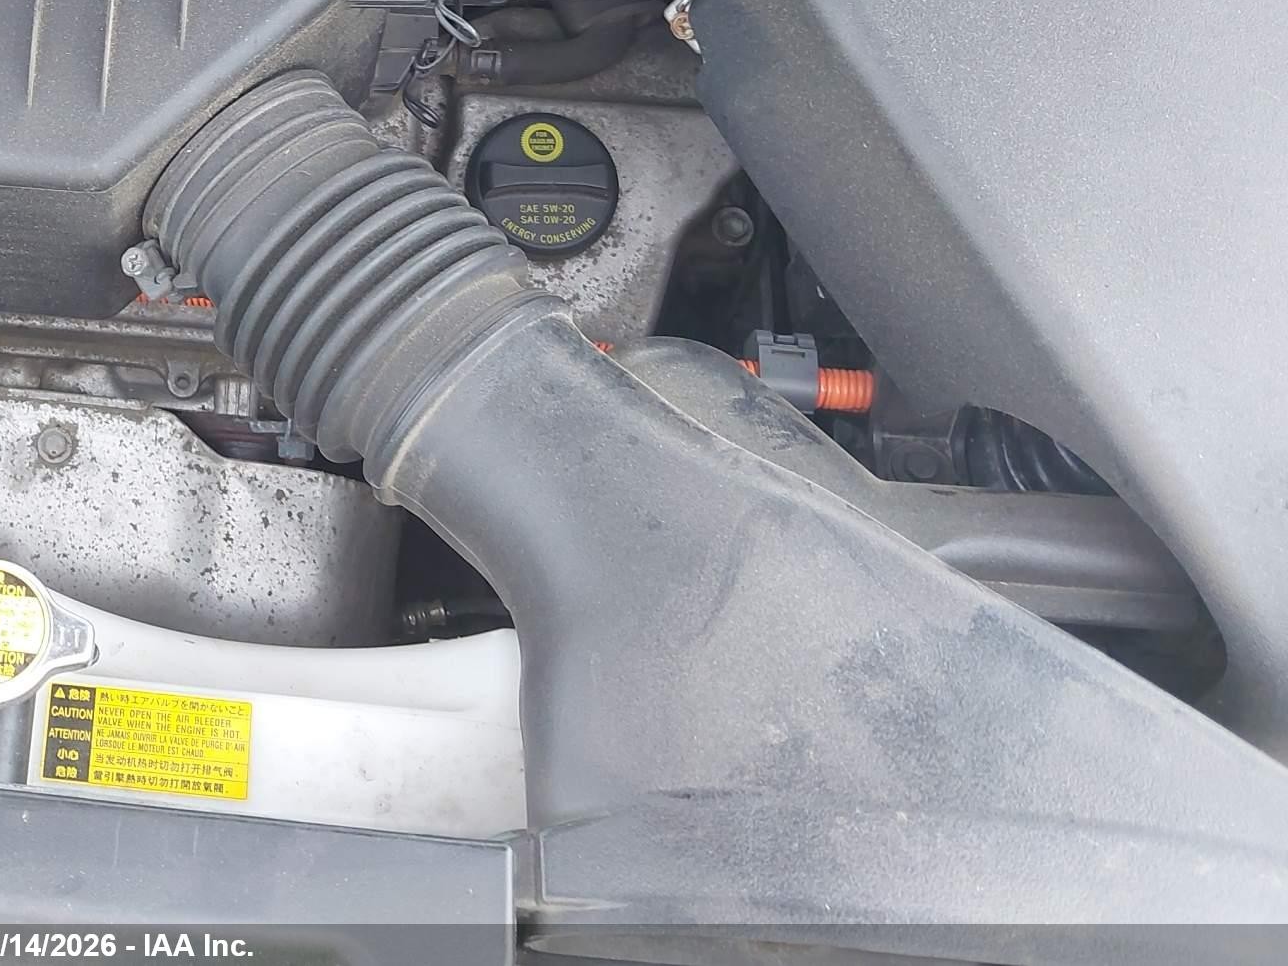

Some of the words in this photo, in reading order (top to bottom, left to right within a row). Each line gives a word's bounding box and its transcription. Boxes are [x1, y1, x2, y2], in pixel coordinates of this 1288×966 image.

[519, 204, 540, 214] SAE
[542, 204, 575, 214] 5W-20
[520, 215, 541, 225] SAE
[543, 215, 577, 225] 0W-20
[502, 217, 537, 241] ENERGY
[539, 217, 596, 244] CONSERVING
[51, 705, 93, 721] CAUTION
[99, 707, 125, 718] NEVER
[129, 709, 152, 720] OPEN
[157, 712, 172, 722] THE
[176, 714, 190, 724] AIR
[195, 716, 232, 729] BLEEDER
[48, 727, 91, 743] ATTENTION
[97, 717, 123, 728] VALVE
[126, 719, 152, 730] WHEN
[156, 722, 171, 732] THE
[175, 724, 206, 737] ENGINE
[211, 728, 219, 738] IS
[95, 738, 125, 750] LORSQUE
[127, 742, 135, 751] LE
[138, 743, 165, 755] MOTEUR
[167, 746, 180, 755] EST
[97, 728, 105, 737] NE
[107, 730, 131, 741] JAMAIS
[133, 732, 158, 744] OUVRIR
[159, 735, 168, 744] LA
[169, 736, 190, 746] VALVE
[191, 738, 200, 748] DE
[201, 739, 223, 750] PURGE
